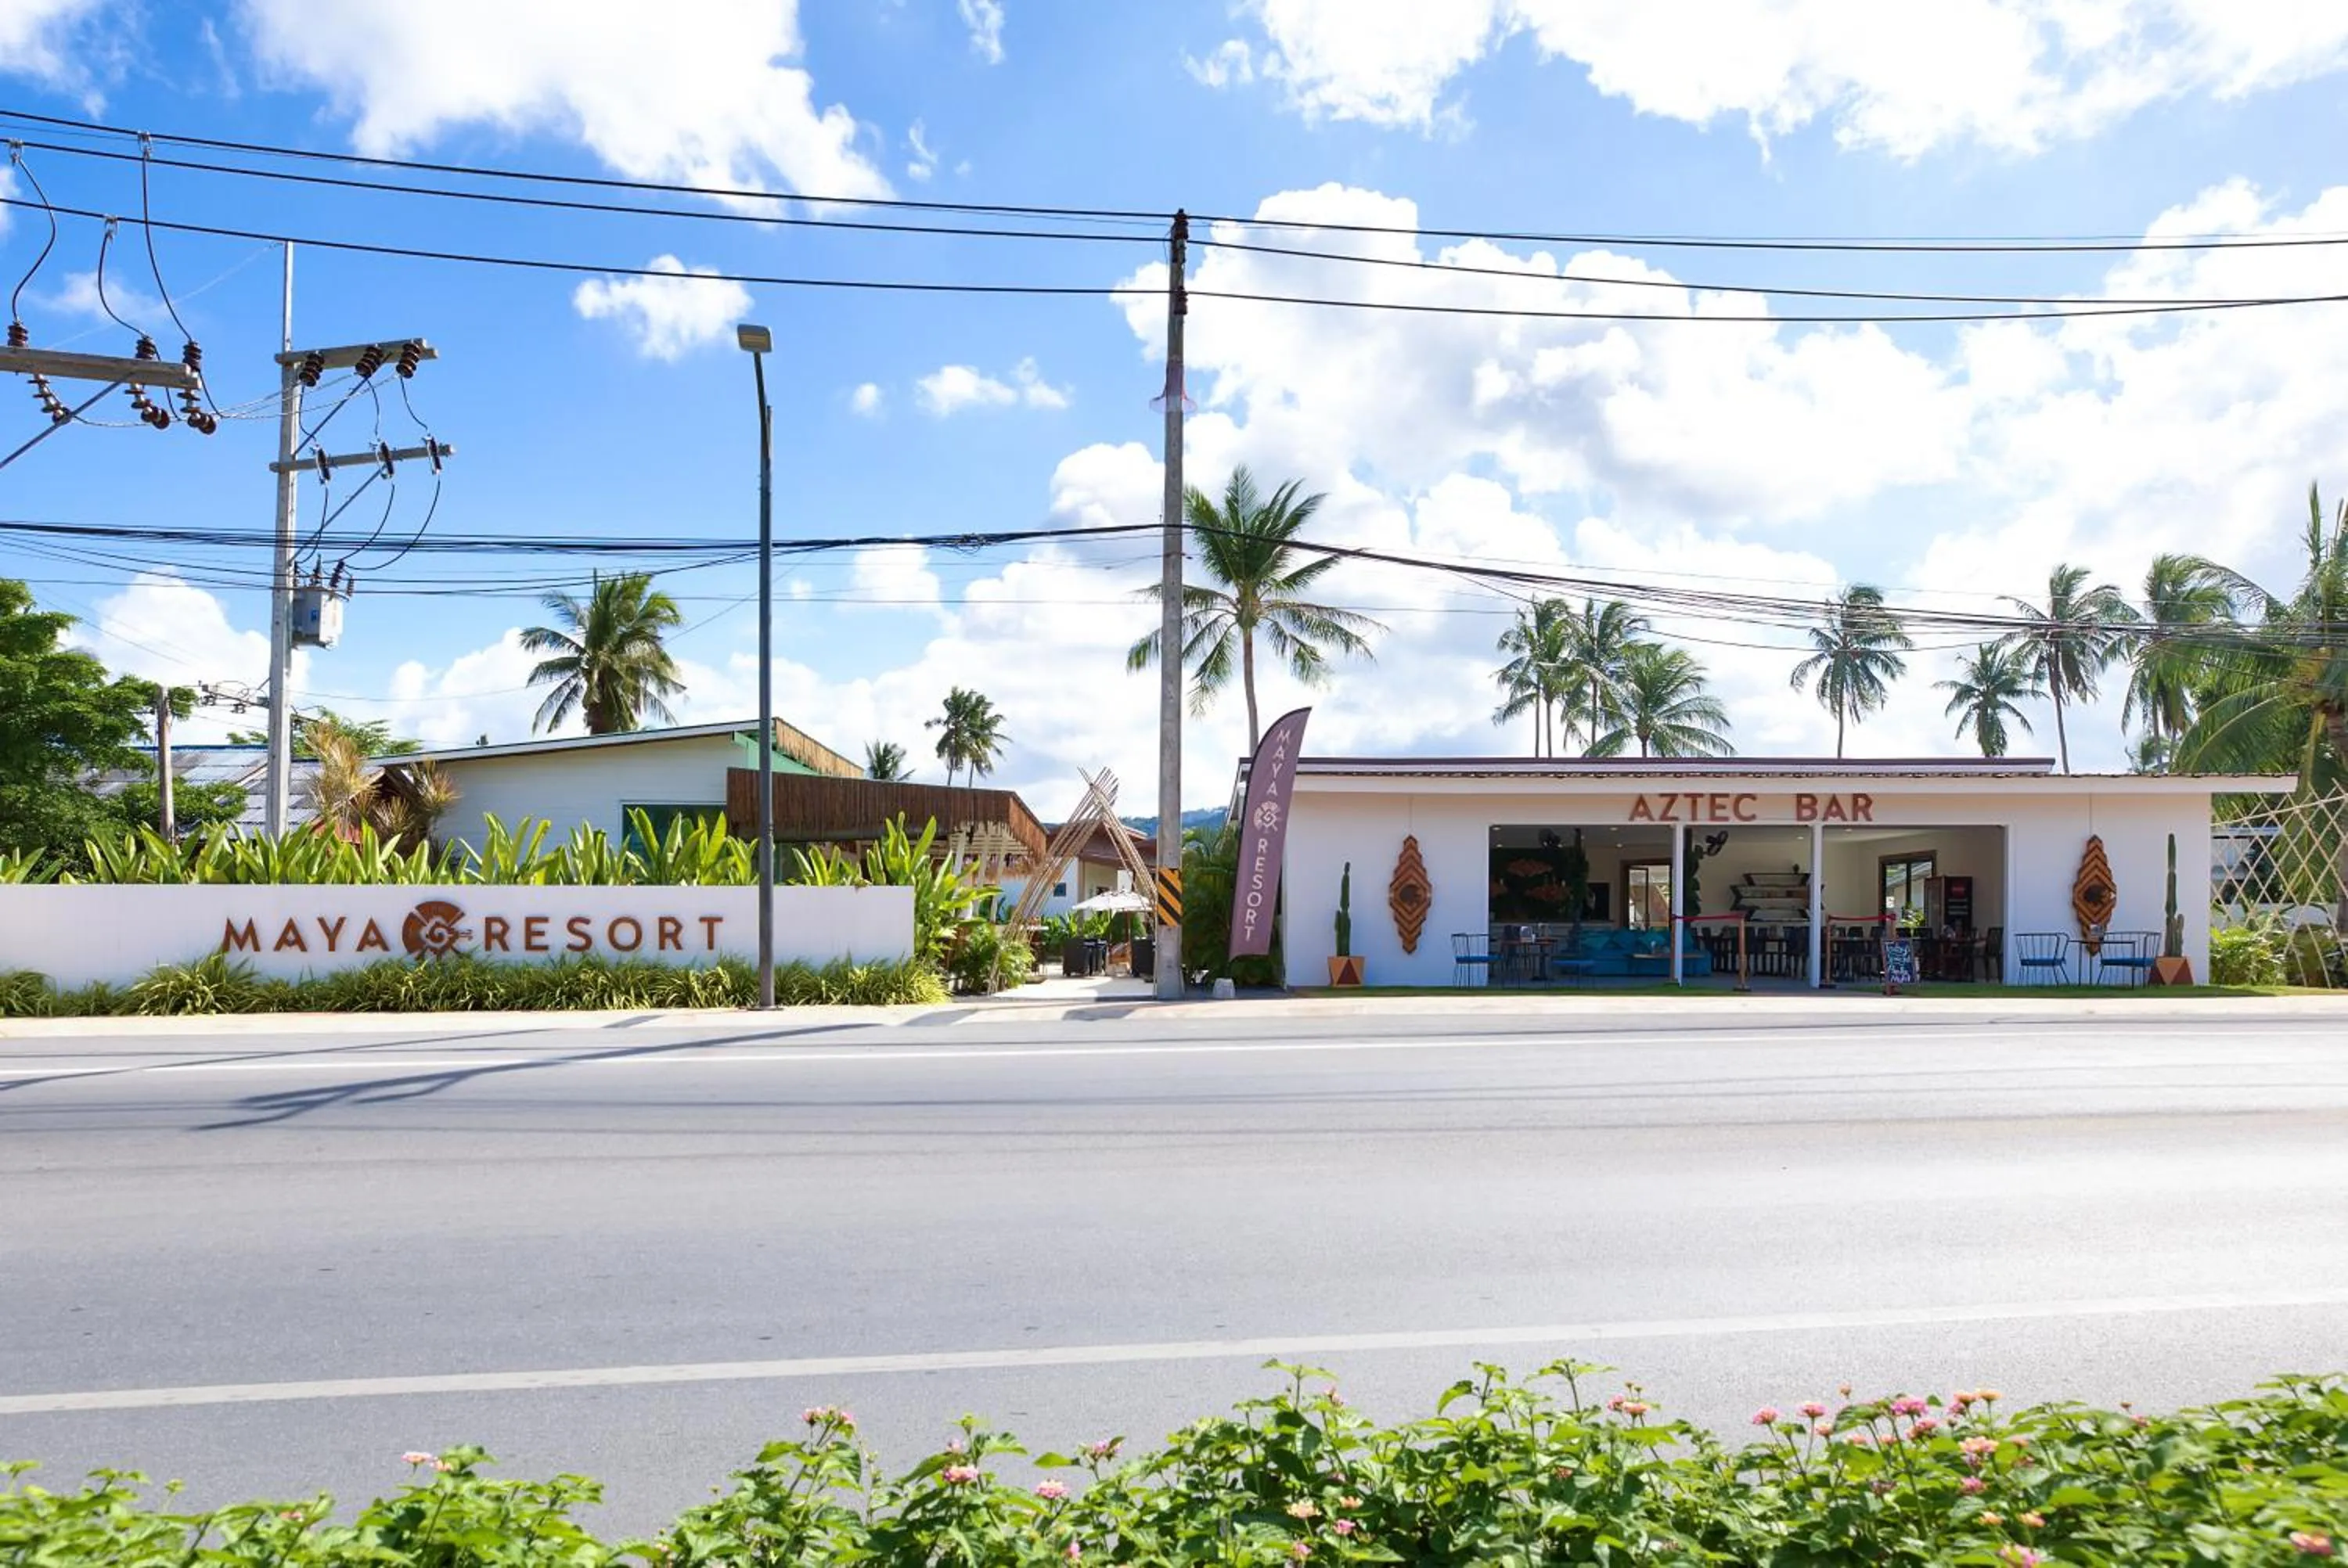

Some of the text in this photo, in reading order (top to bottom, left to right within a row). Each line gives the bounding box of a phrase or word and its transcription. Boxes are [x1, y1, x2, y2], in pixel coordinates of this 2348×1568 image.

[1628, 793, 1874, 822] AZTEC BAR
[1244, 728, 1291, 941] MAYA RESORT
[222, 916, 724, 952] MAYA RESORT
